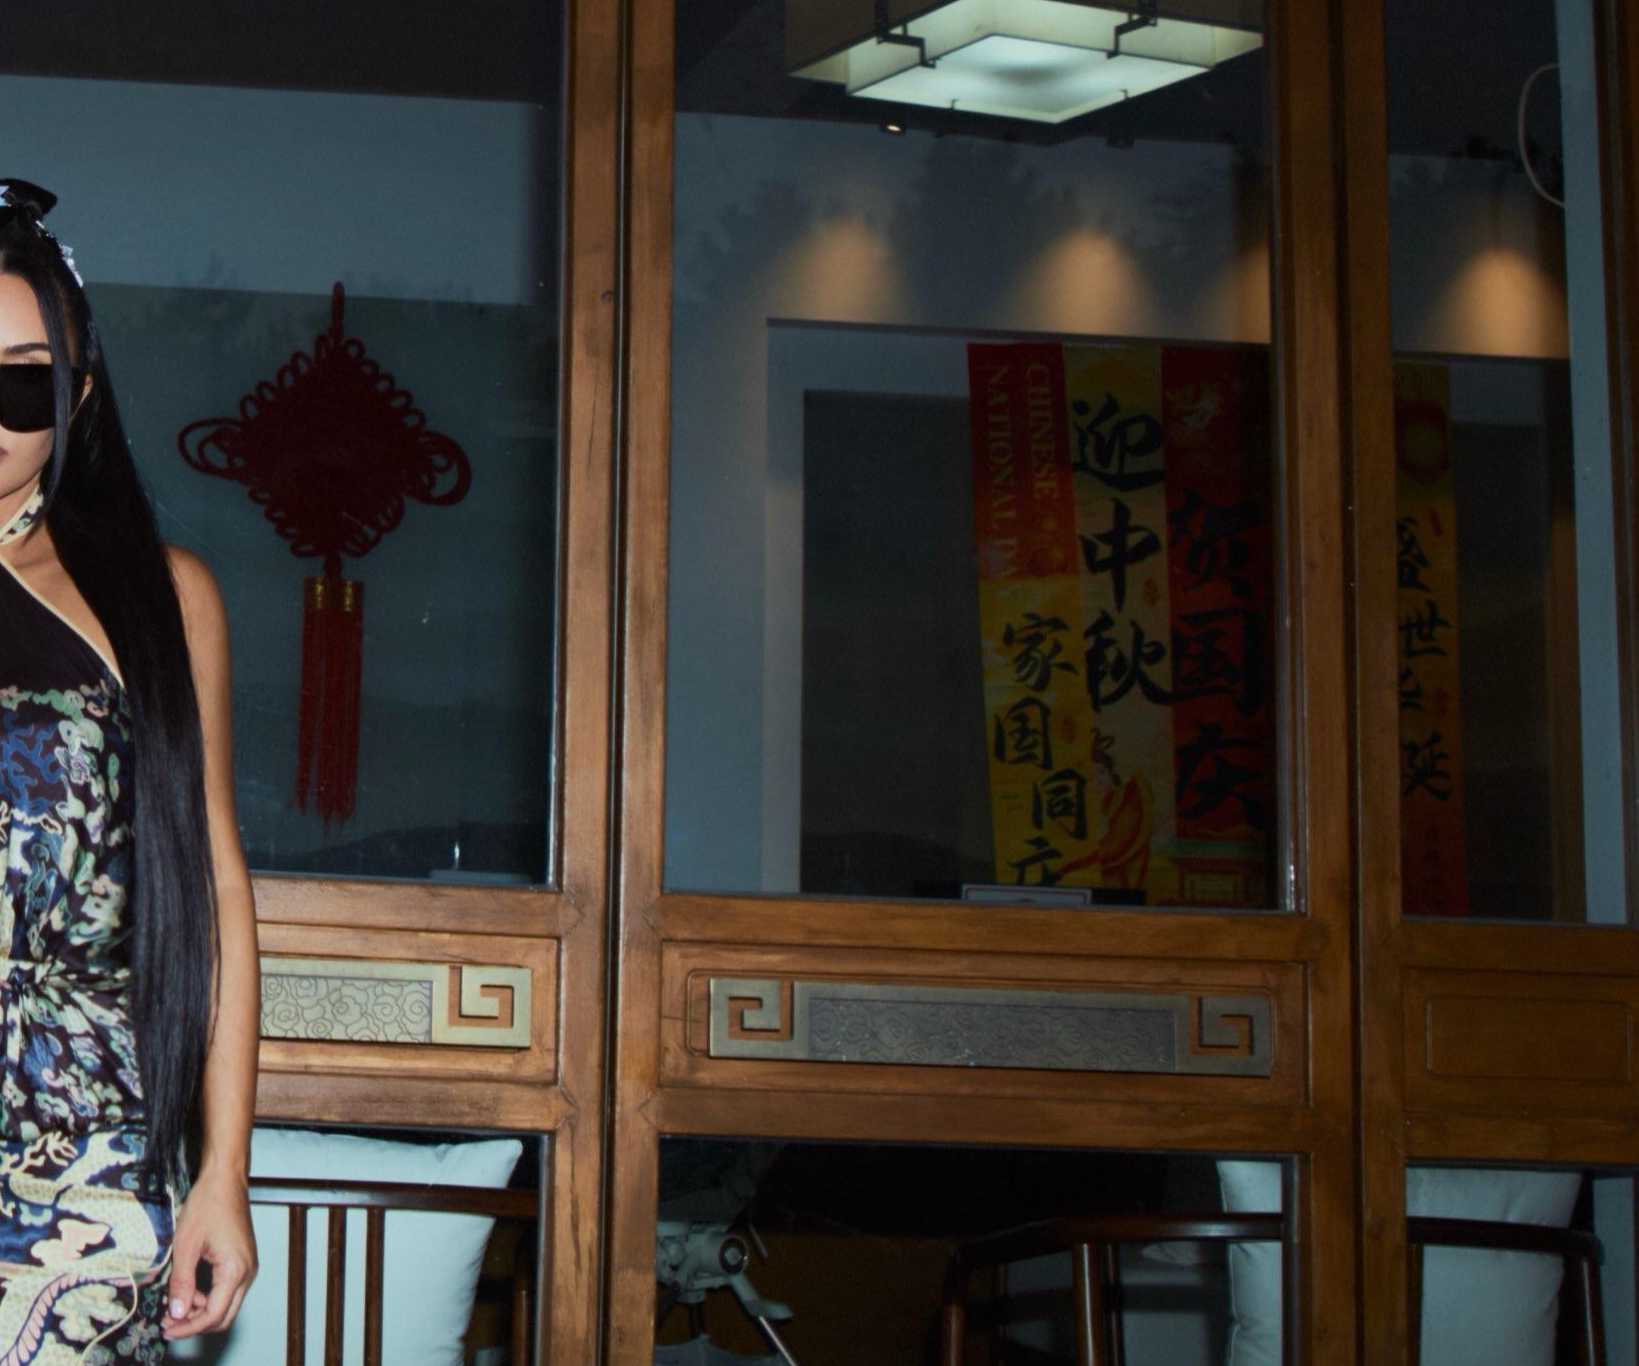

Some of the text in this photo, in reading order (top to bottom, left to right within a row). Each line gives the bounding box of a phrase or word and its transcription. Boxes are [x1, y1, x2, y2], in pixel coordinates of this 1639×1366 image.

[985, 364, 1019, 580] NATIONAL DA
[1027, 363, 1059, 499] CHINESE
[1071, 392, 1175, 713] 迎中秋
[1169, 488, 1264, 832] 贺国庆
